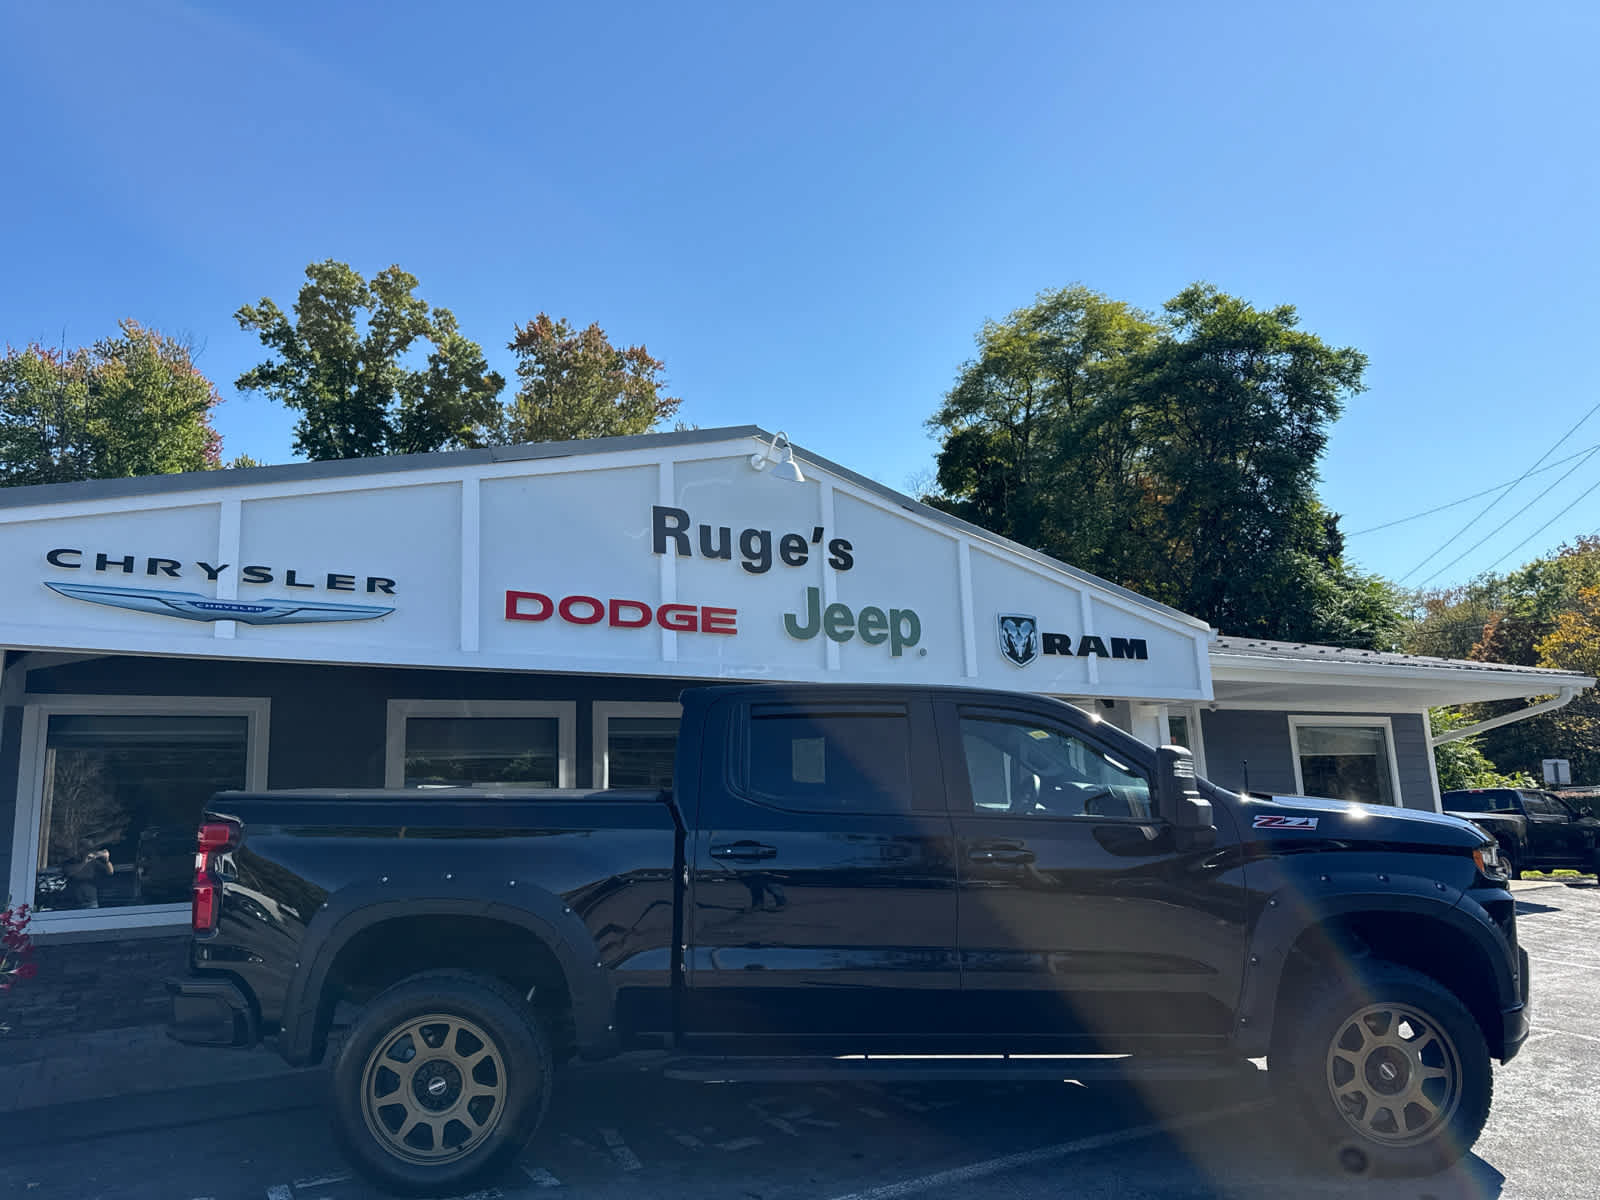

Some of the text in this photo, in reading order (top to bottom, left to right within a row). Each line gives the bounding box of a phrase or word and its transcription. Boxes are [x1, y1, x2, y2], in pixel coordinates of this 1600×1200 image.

[652, 505, 855, 575] Ruge's
[46, 548, 397, 594] CHRYSLER
[505, 590, 738, 635] DODGE
[1042, 632, 1149, 660] RAM
[1252, 815, 1319, 831] Z71
